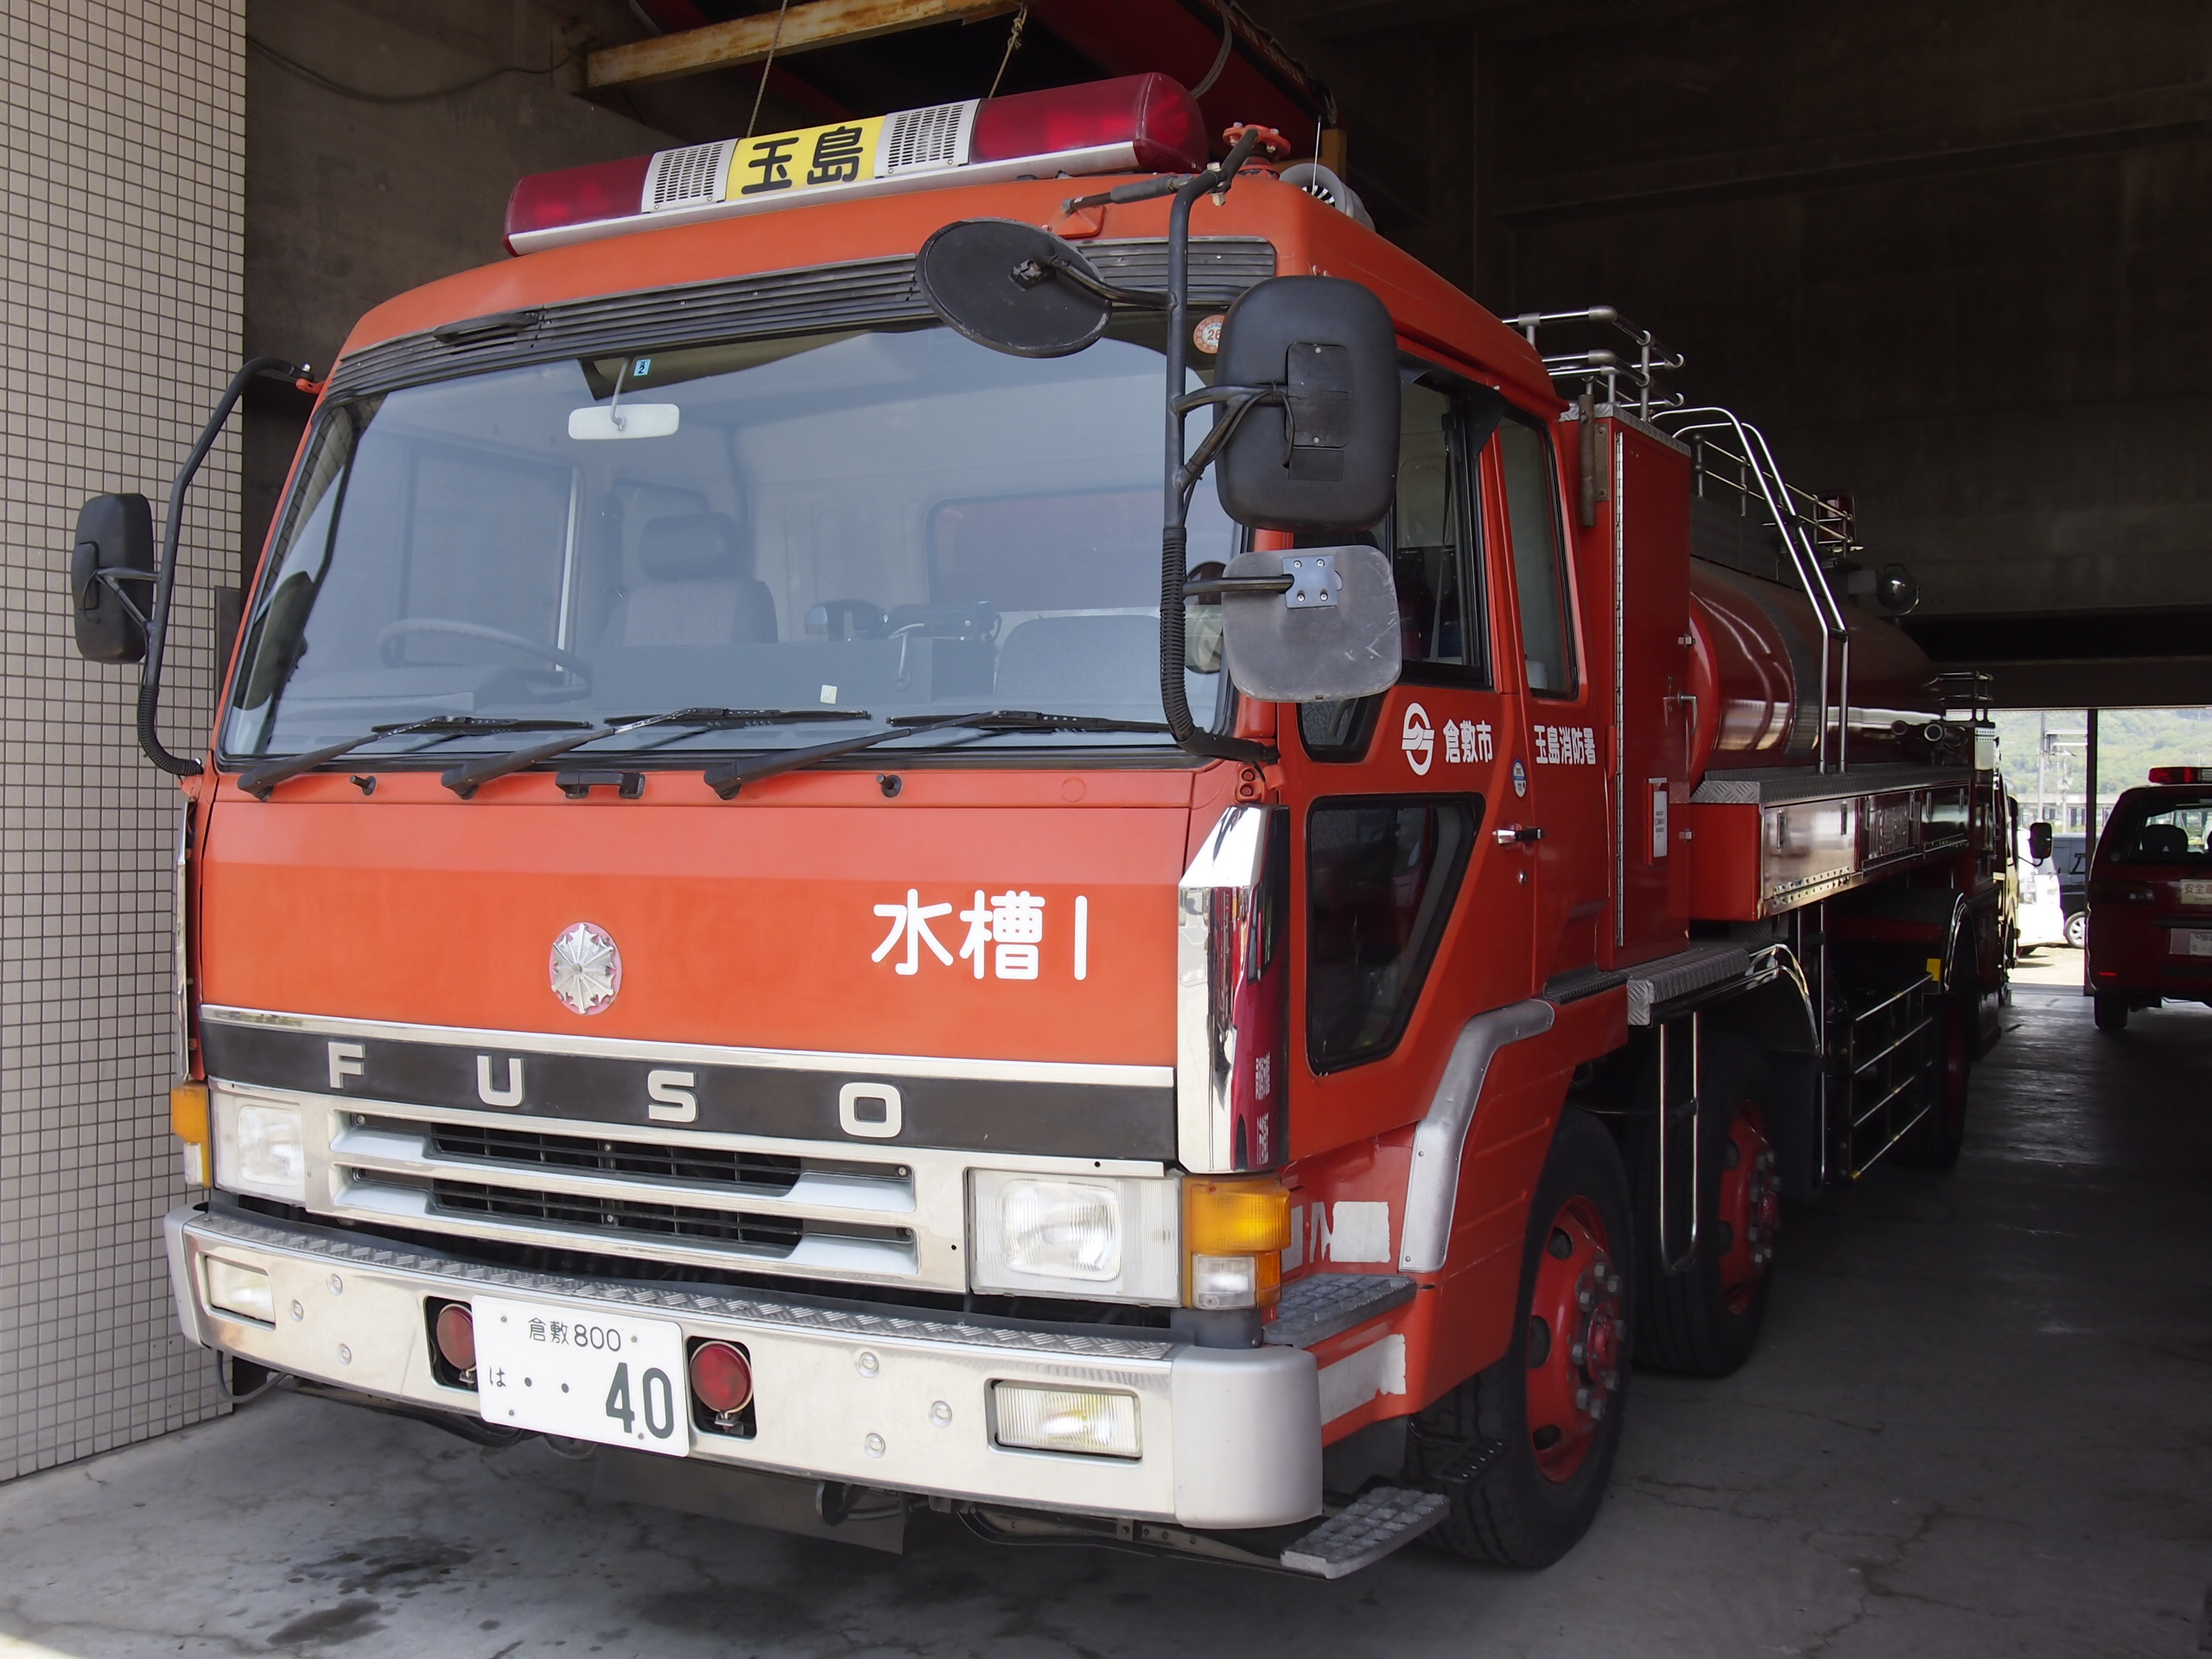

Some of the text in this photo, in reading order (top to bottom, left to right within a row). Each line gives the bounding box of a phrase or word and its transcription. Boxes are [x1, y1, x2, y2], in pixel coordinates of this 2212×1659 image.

[741, 125, 863, 194] 玉島
[1207, 329, 1221, 340] 26
[1443, 718, 1493, 763] 倉敷市
[1534, 725, 1597, 765] 玉島消防署
[327, 1040, 903, 1140] FUSO
